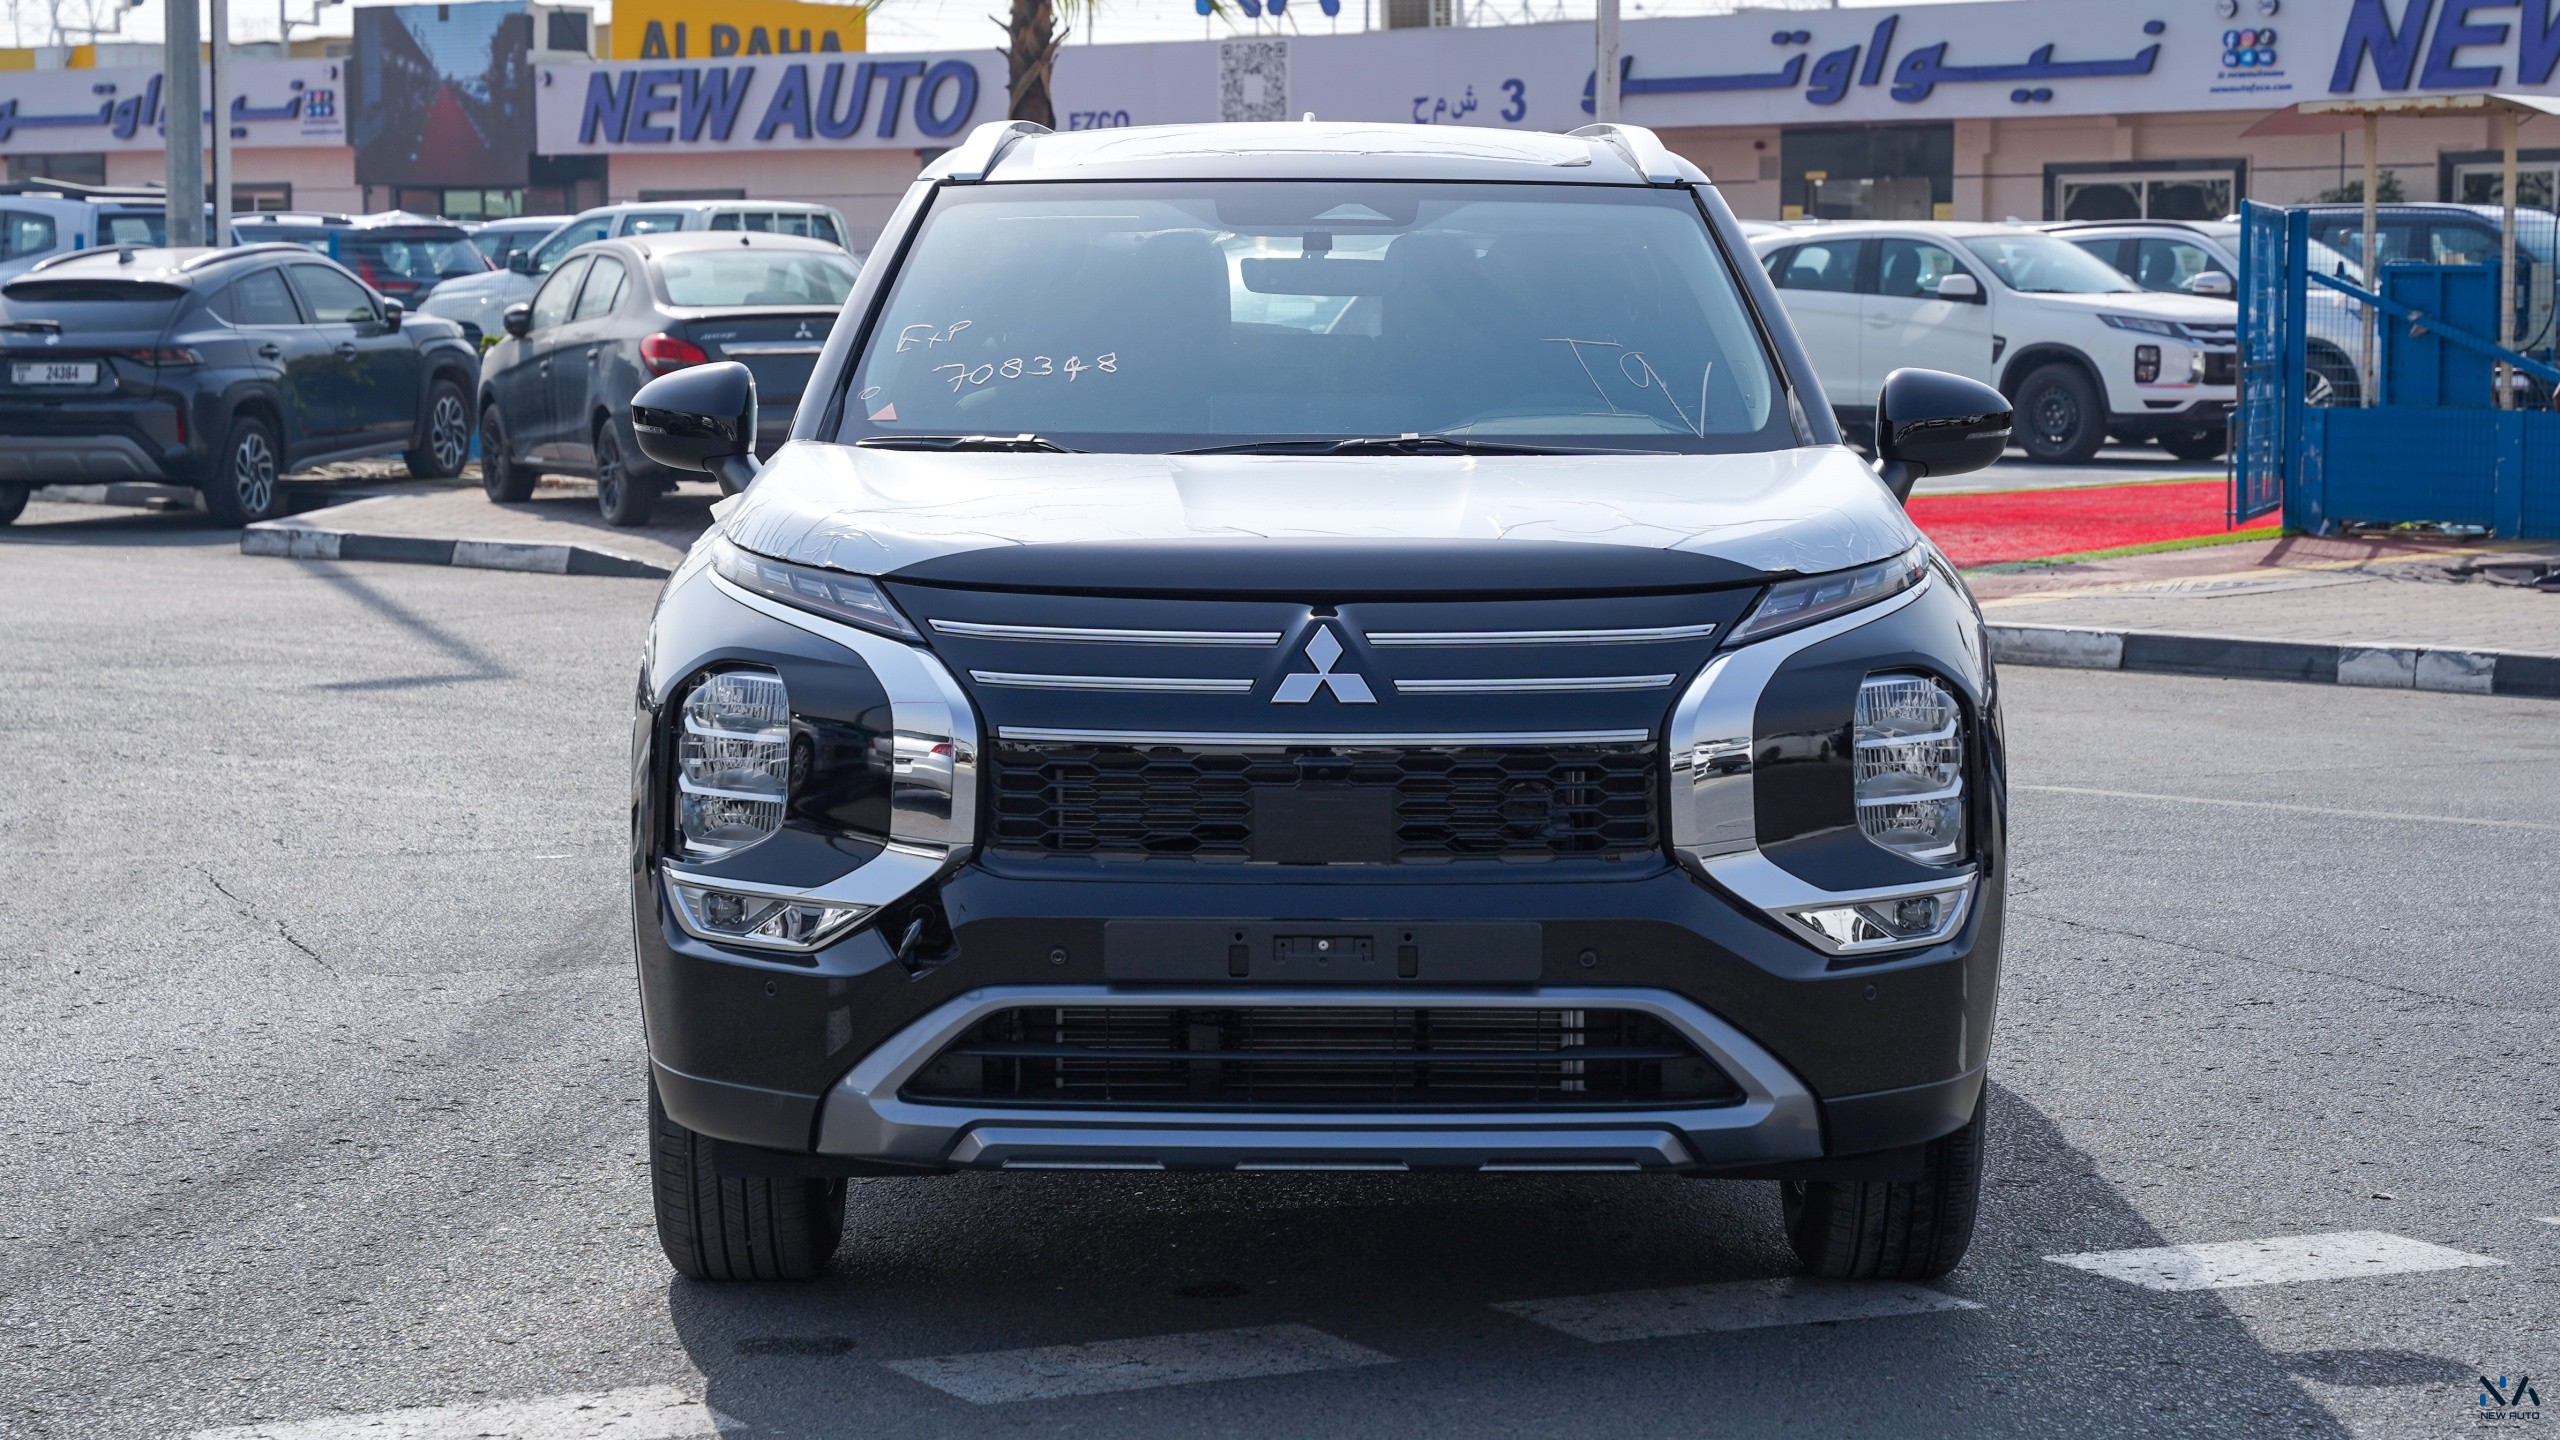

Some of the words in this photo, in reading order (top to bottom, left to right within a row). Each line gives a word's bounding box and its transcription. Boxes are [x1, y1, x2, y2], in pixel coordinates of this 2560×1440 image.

[578, 66, 756, 144] NEW
[754, 60, 979, 139] AUTO
[1501, 78, 1527, 122] 3
[932, 352, 1118, 393] 708348
